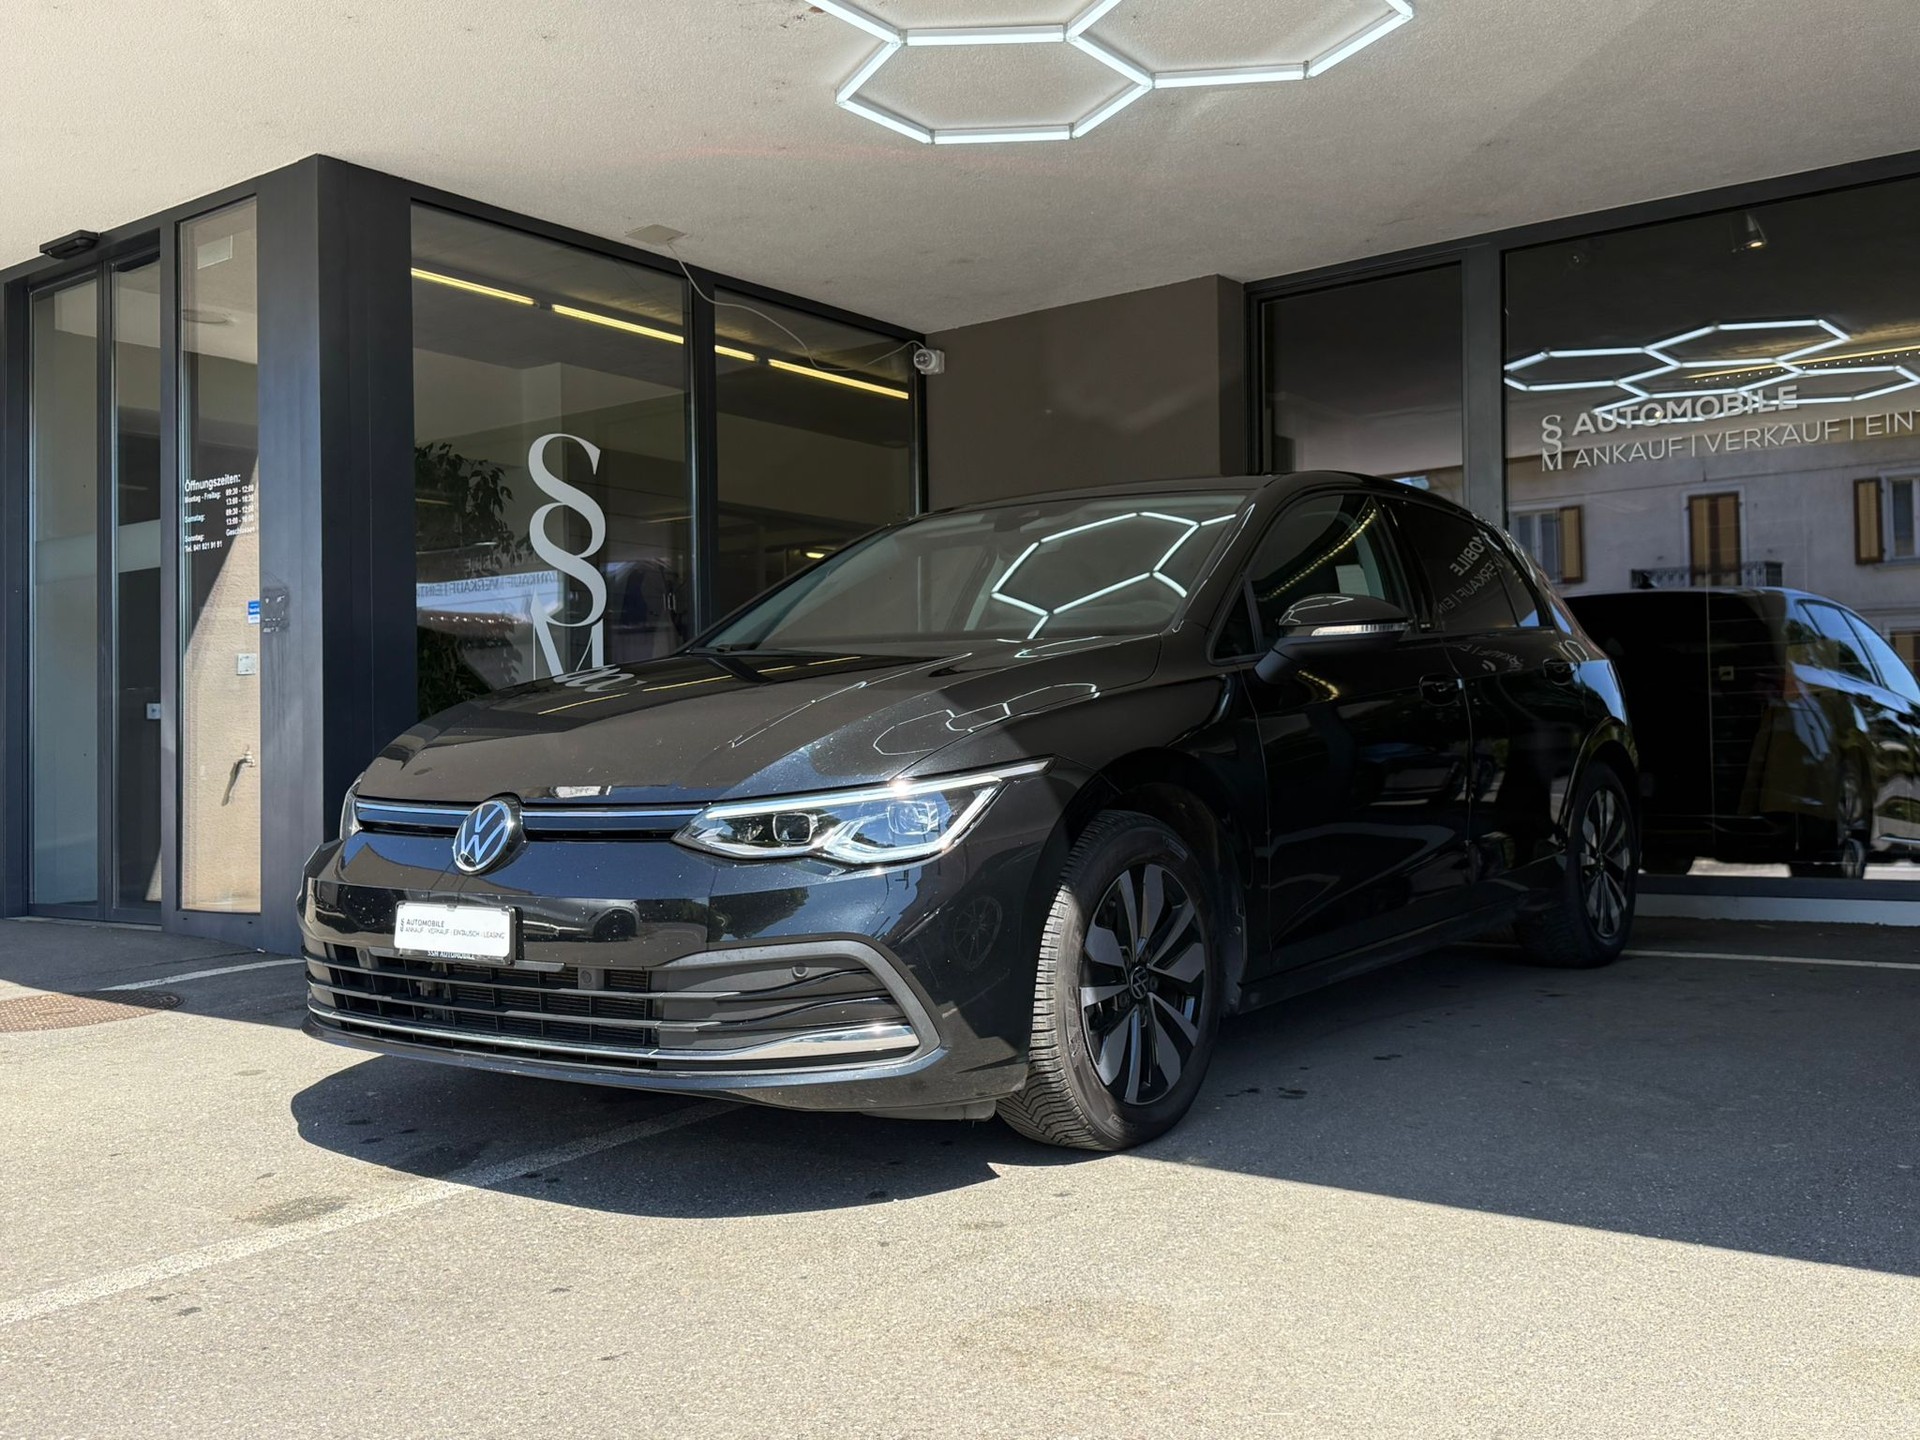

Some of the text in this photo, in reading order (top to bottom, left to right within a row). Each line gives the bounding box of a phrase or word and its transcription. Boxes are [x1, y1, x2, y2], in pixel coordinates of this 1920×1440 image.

[1571, 385, 1798, 436] AUTOMOBILE
[1572, 437, 1683, 469] ANKAUF
[1704, 418, 1840, 453] VERKAUF
[1865, 409, 1920, 436] EIN
[184, 473, 241, 492] Öffnungszeiten:
[406, 919, 445, 928] AUTOMOBILE
